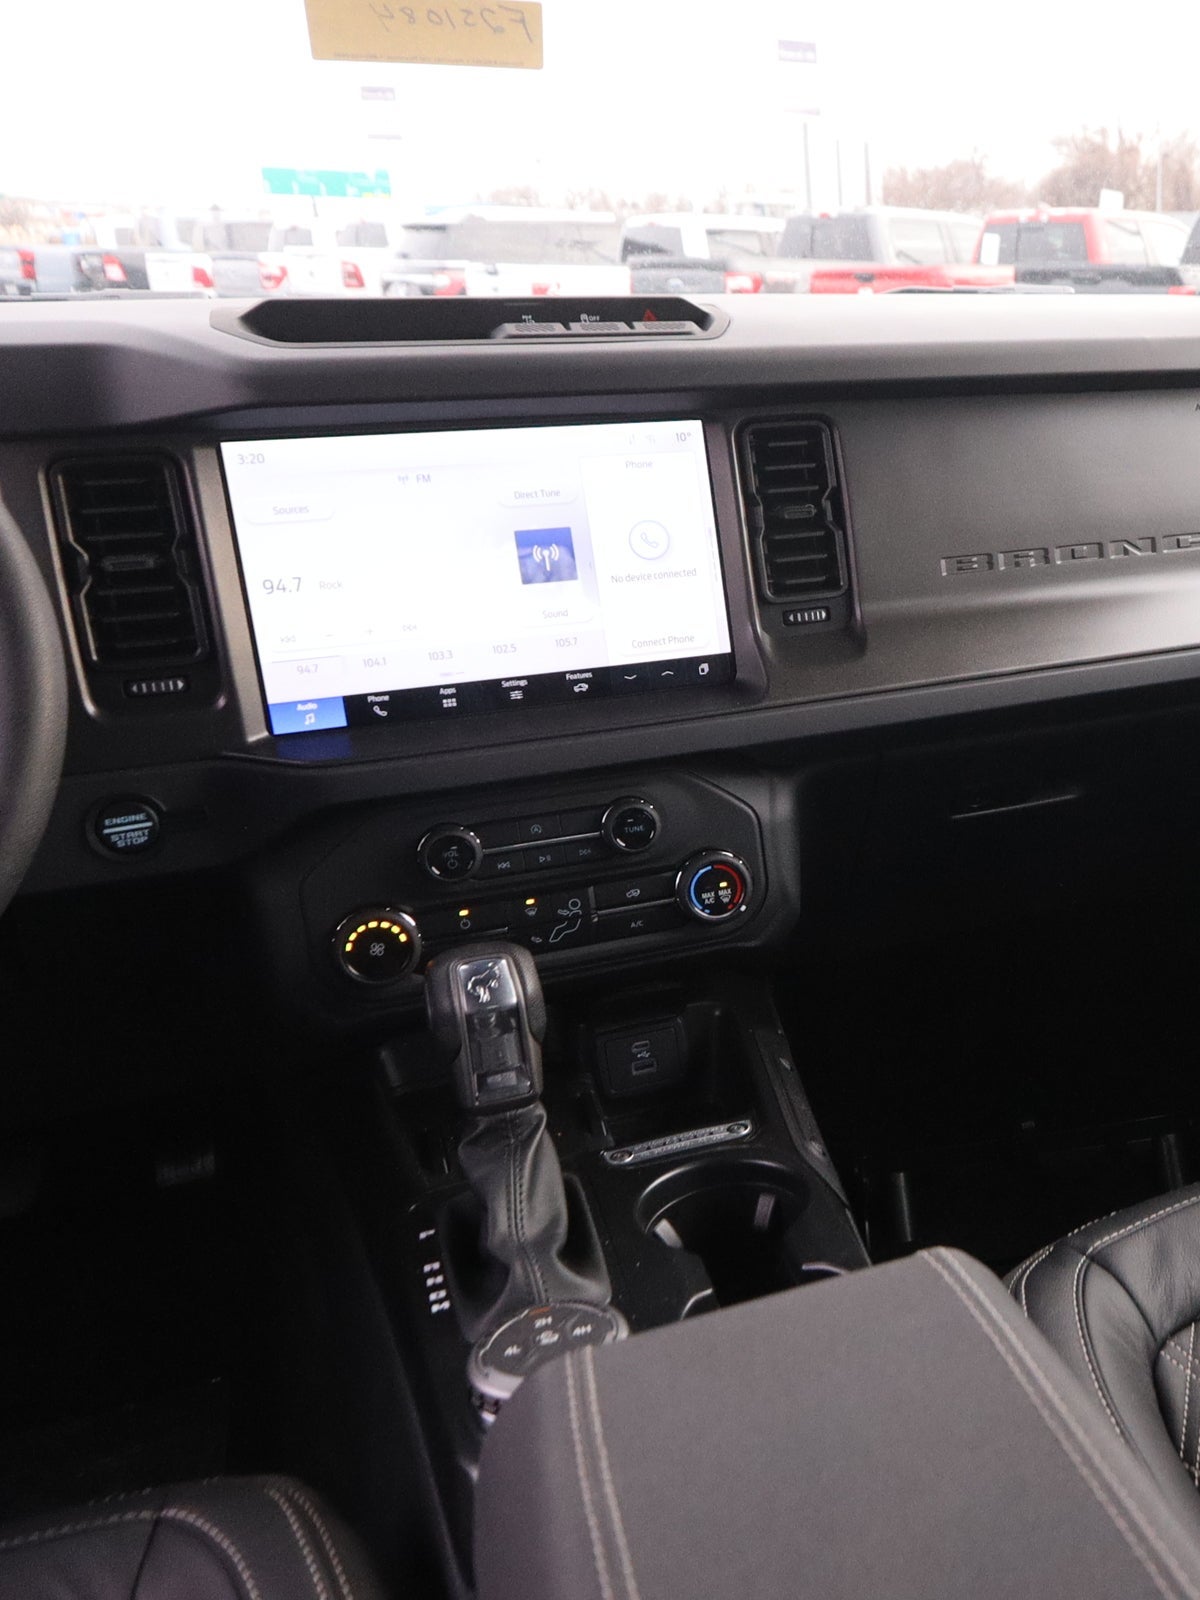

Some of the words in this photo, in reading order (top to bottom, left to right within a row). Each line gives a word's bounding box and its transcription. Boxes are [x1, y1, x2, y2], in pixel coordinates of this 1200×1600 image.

[237, 453, 266, 465] 3:20
[625, 459, 653, 469] Phone
[415, 474, 432, 483] FM
[513, 490, 538, 500] Direct
[540, 488, 561, 498] Tune
[272, 504, 310, 515] Sources
[611, 574, 624, 583] No
[625, 571, 652, 582] device
[653, 568, 697, 580] connected
[262, 577, 303, 595] 94.7
[318, 579, 343, 590] Rock
[542, 608, 569, 620] Sound
[555, 637, 578, 648] 105.7
[631, 638, 666, 649] Connect
[668, 634, 695, 645] Phone
[492, 643, 517, 654] 102.5
[428, 650, 454, 661] 103.3
[363, 657, 387, 668] 104.1
[296, 664, 319, 675] 94.7
[565, 671, 593, 681] Features
[501, 678, 528, 689] Settings
[439, 686, 457, 695] Apps
[367, 694, 390, 703] Phone
[296, 702, 318, 711] Audio
[104, 813, 147, 825] ENGINE
[624, 824, 645, 833] TUNE
[111, 829, 149, 841] START
[117, 836, 148, 847] STOP
[630, 920, 644, 928] A/C
